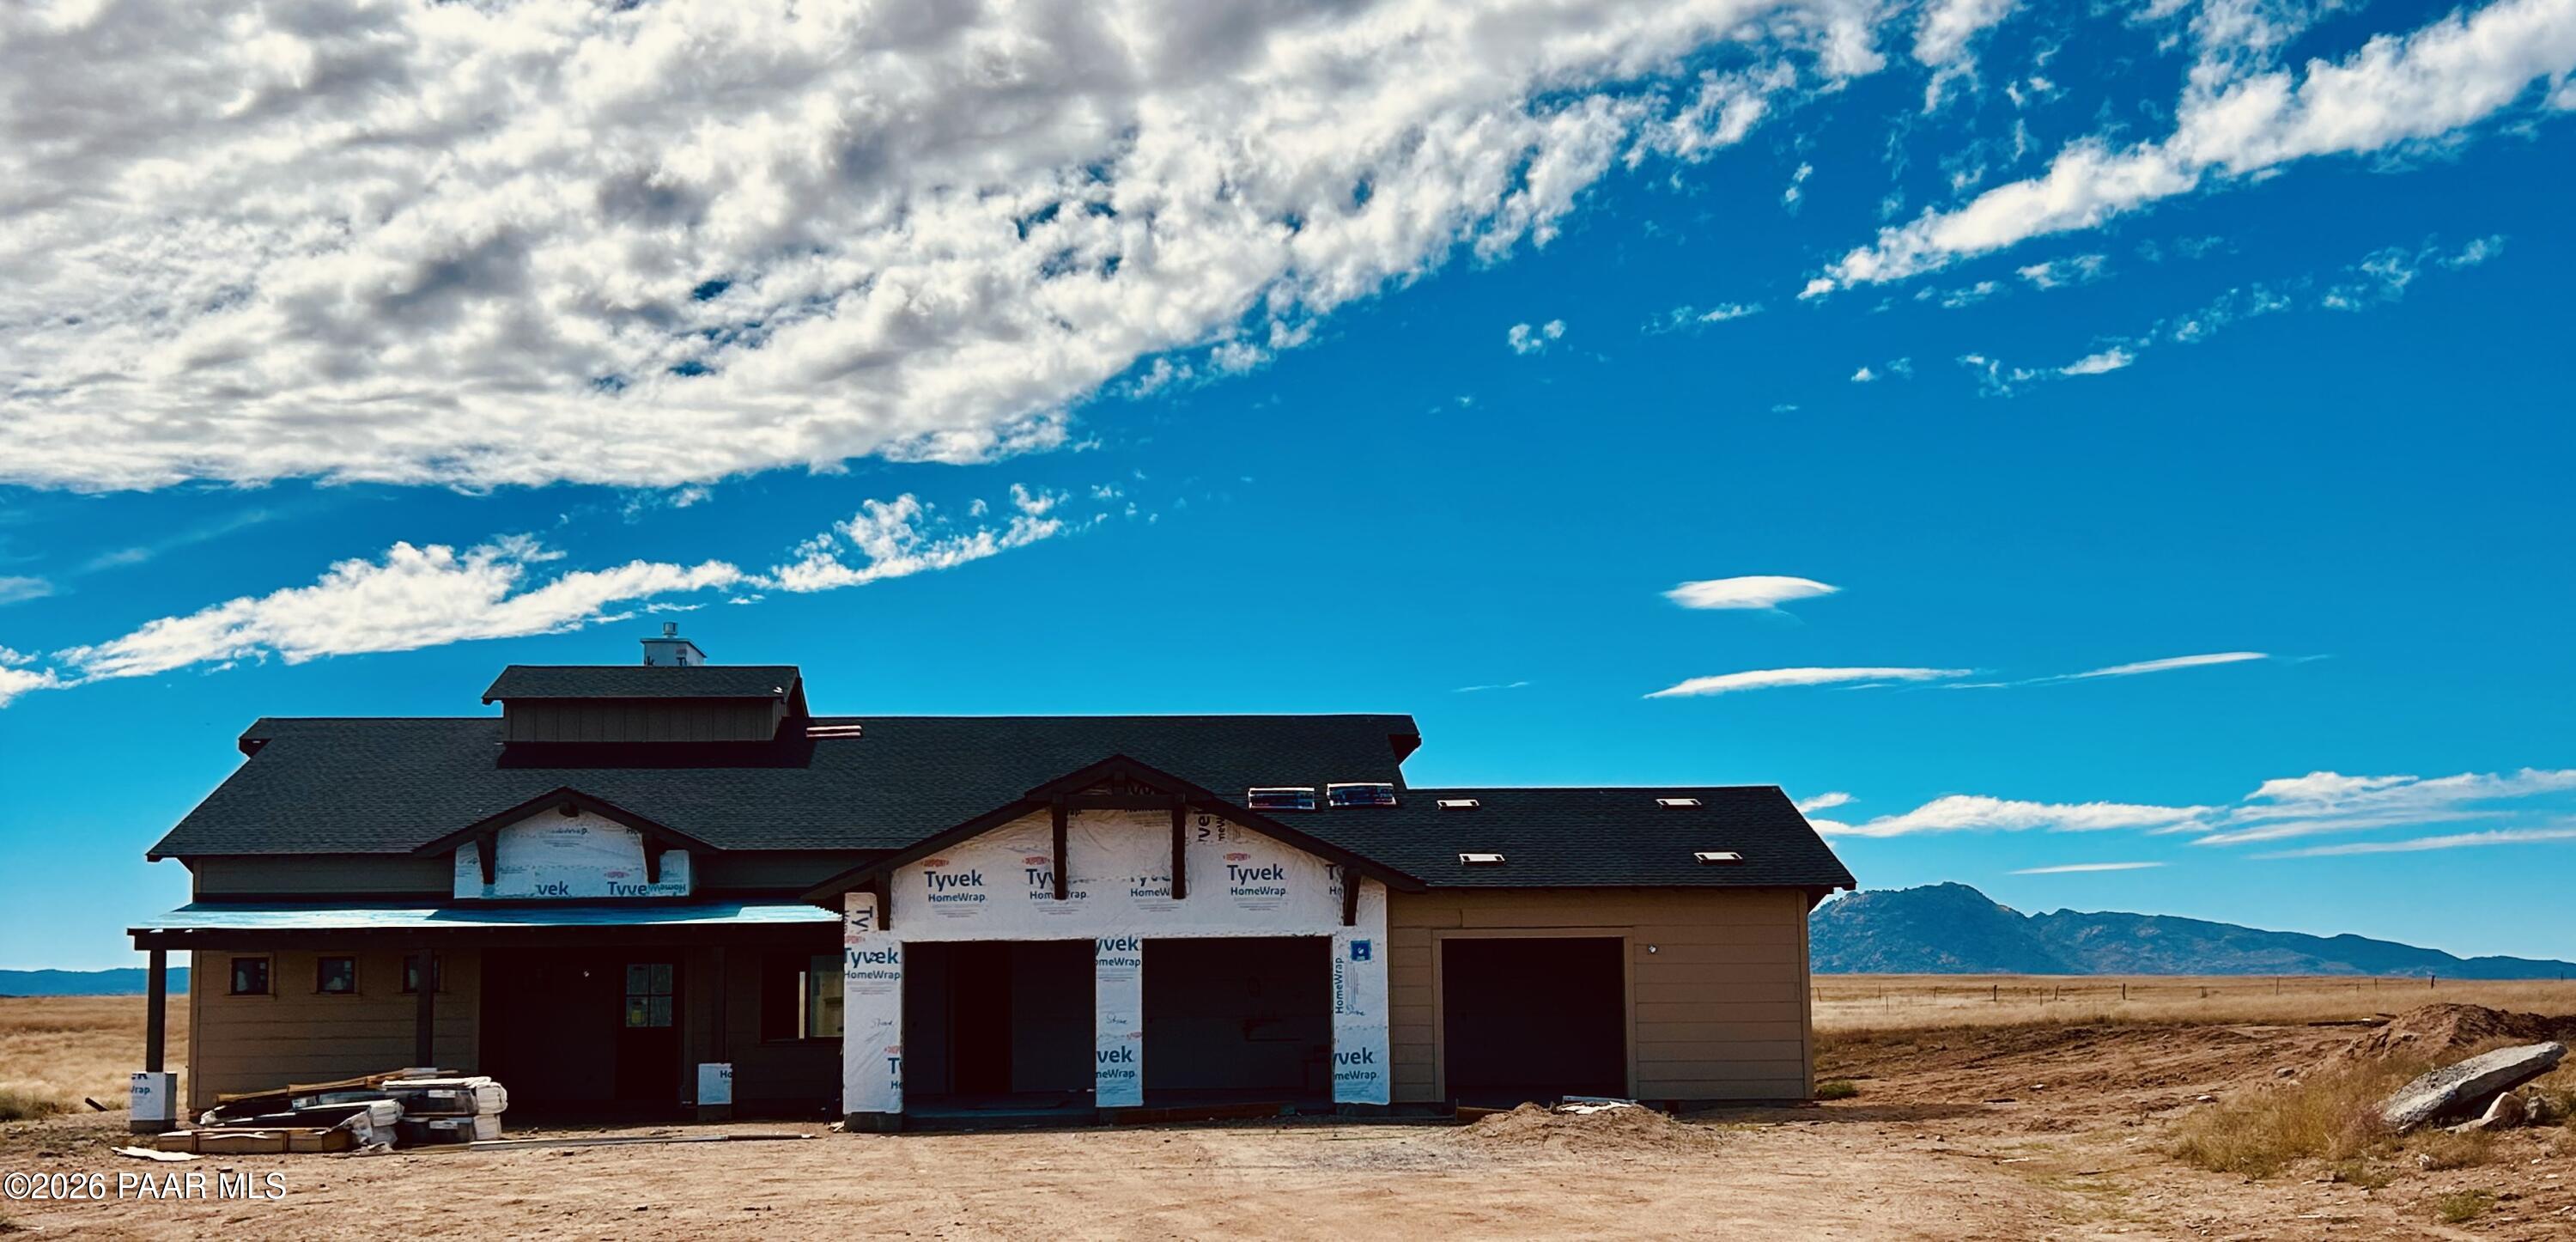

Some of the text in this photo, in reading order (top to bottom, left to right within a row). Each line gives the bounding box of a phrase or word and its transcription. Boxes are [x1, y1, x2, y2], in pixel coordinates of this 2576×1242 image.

[924, 869, 983, 892] Tyvek
[1227, 863, 1285, 886] Tyvek
[928, 892, 986, 903] HomeWrap
[1230, 886, 1286, 897] HomeWrap
[1334, 957, 1344, 1014] HomeWrap
